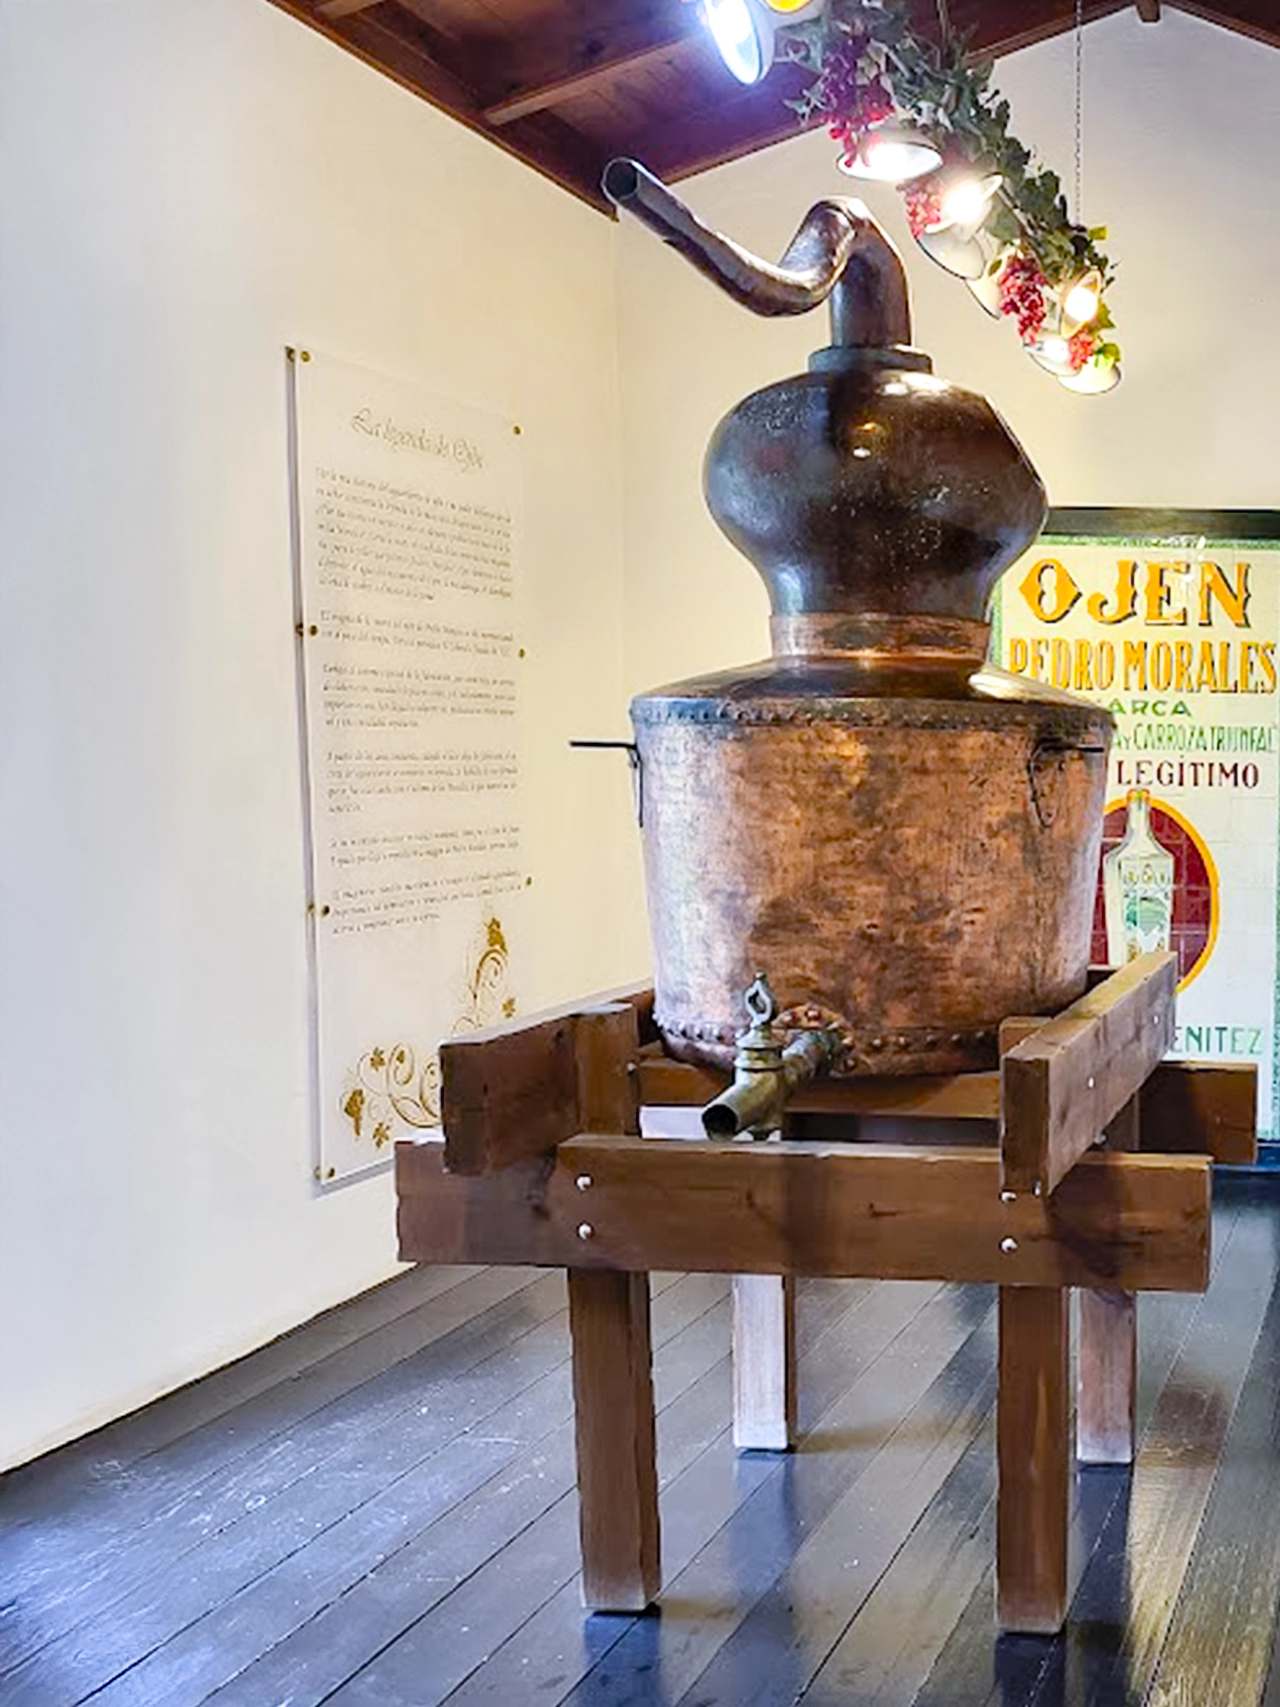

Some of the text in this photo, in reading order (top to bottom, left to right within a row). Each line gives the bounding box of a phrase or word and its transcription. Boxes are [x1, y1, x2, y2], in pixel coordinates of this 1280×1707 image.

[1018, 558, 1252, 629] OJEN
[1008, 637, 1278, 694] PEDRO MORALES
[1108, 698, 1192, 717] ARCA
[1116, 754, 1260, 789] LEGÍTIMO
[1171, 1026, 1263, 1056] ENITEZ
